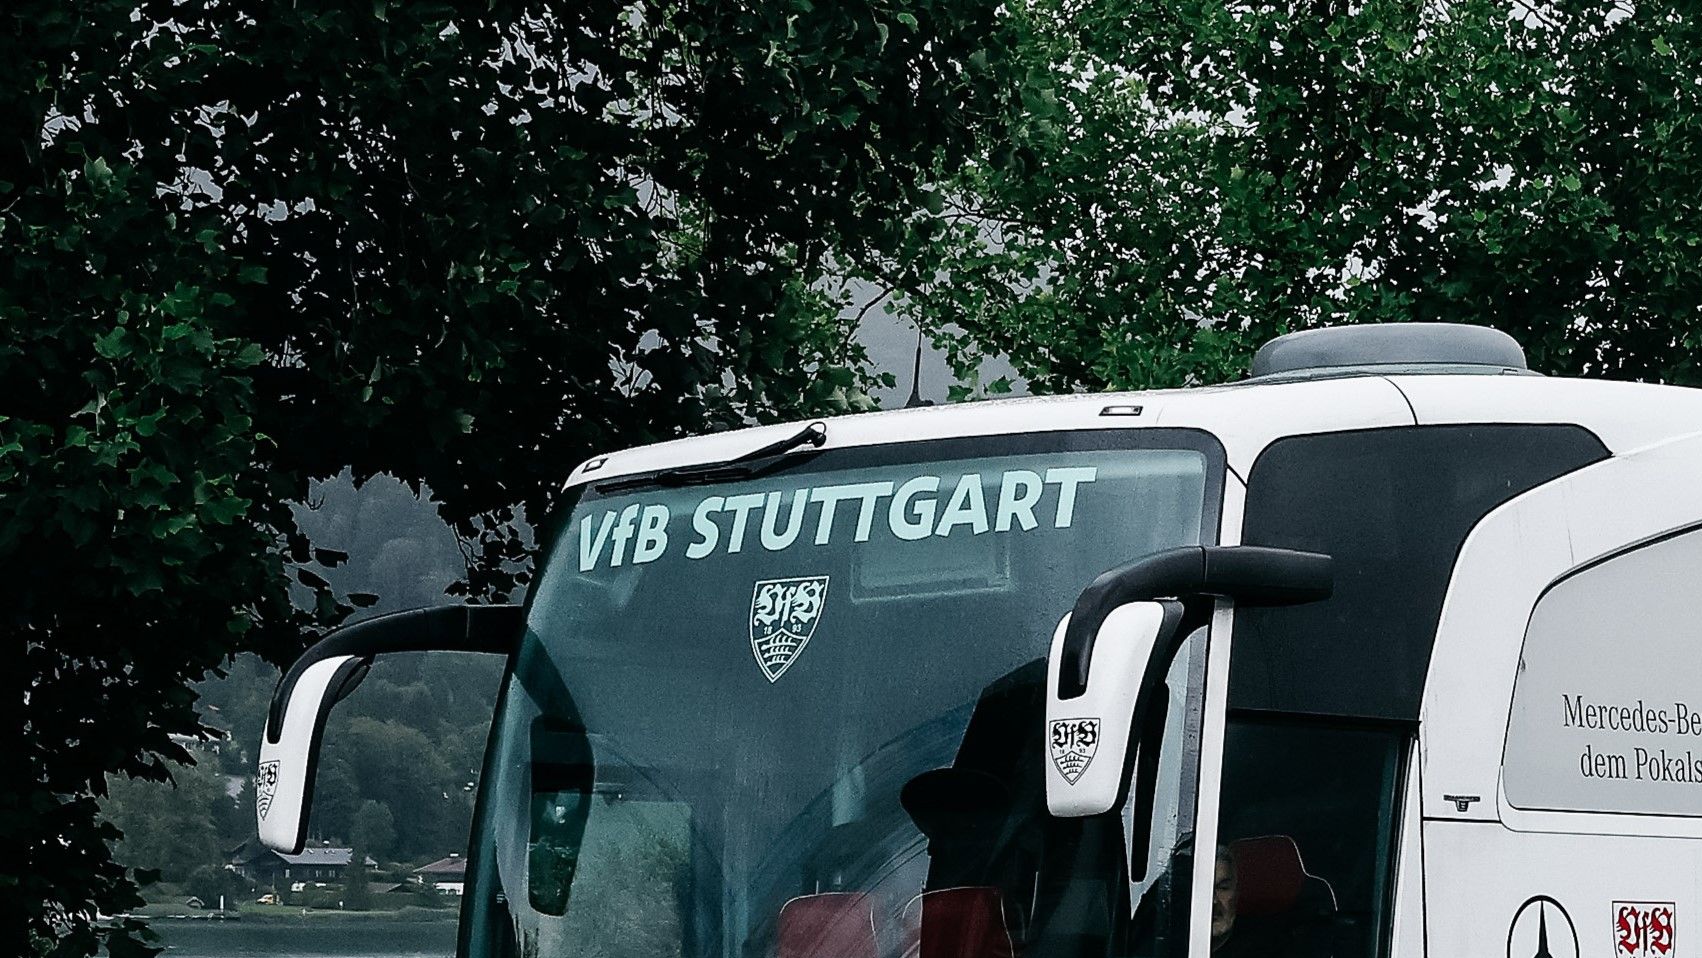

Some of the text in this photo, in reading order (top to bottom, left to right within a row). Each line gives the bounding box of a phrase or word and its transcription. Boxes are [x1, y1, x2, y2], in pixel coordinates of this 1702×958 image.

[578, 467, 1098, 573] VfB STUTTGART
[1580, 745, 1628, 780] dem
